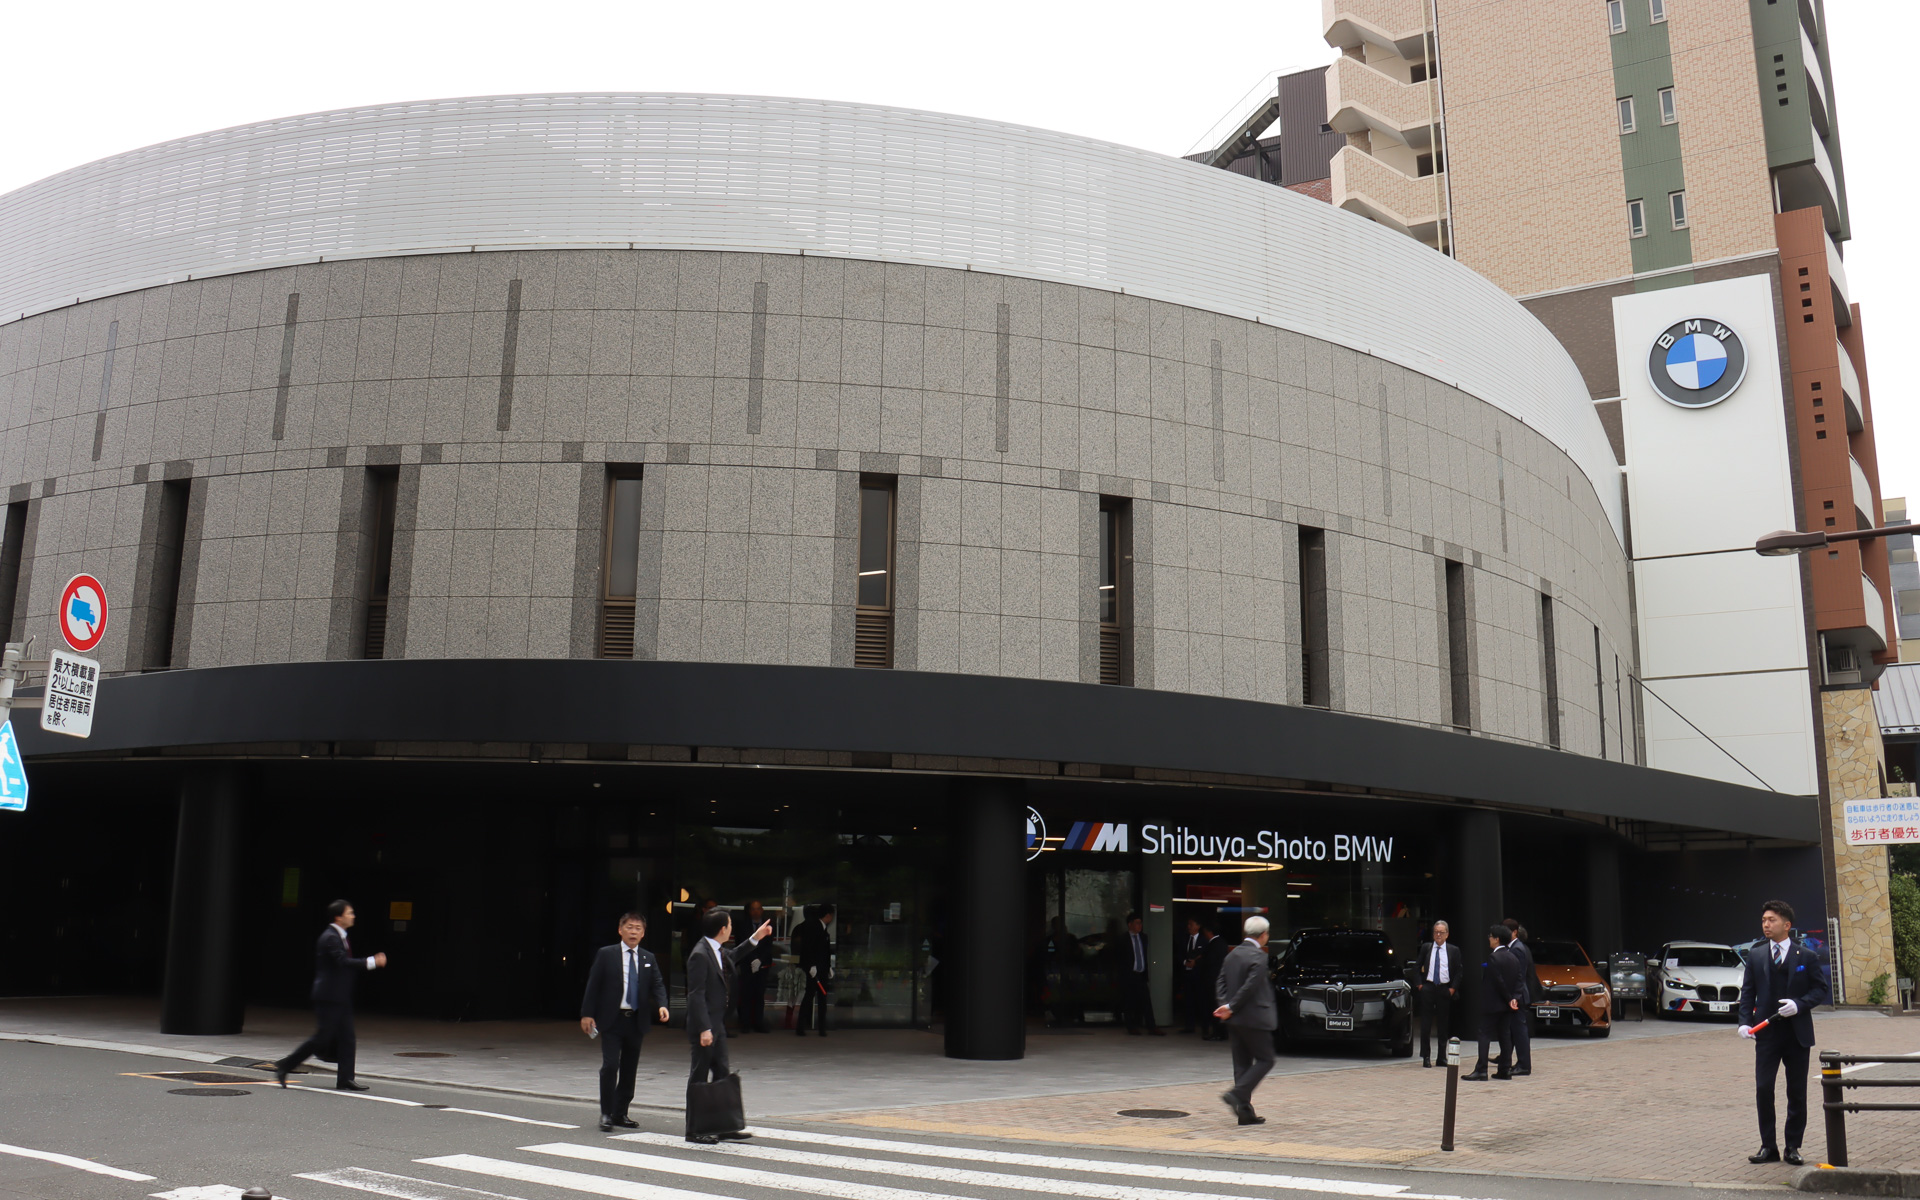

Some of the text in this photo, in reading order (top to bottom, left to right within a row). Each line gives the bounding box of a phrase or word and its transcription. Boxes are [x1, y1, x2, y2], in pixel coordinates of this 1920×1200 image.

[1657, 319, 1732, 350] BMW
[54, 657, 96, 682] 最大積載量
[51, 673, 94, 697] 2t以上の貨物
[49, 693, 91, 717] 居住者用車両
[46, 711, 67, 728] を除く
[1091, 822, 1393, 863] M Shibuya-Shoto BMW
[1850, 826, 1919, 841] 歩行者優先
